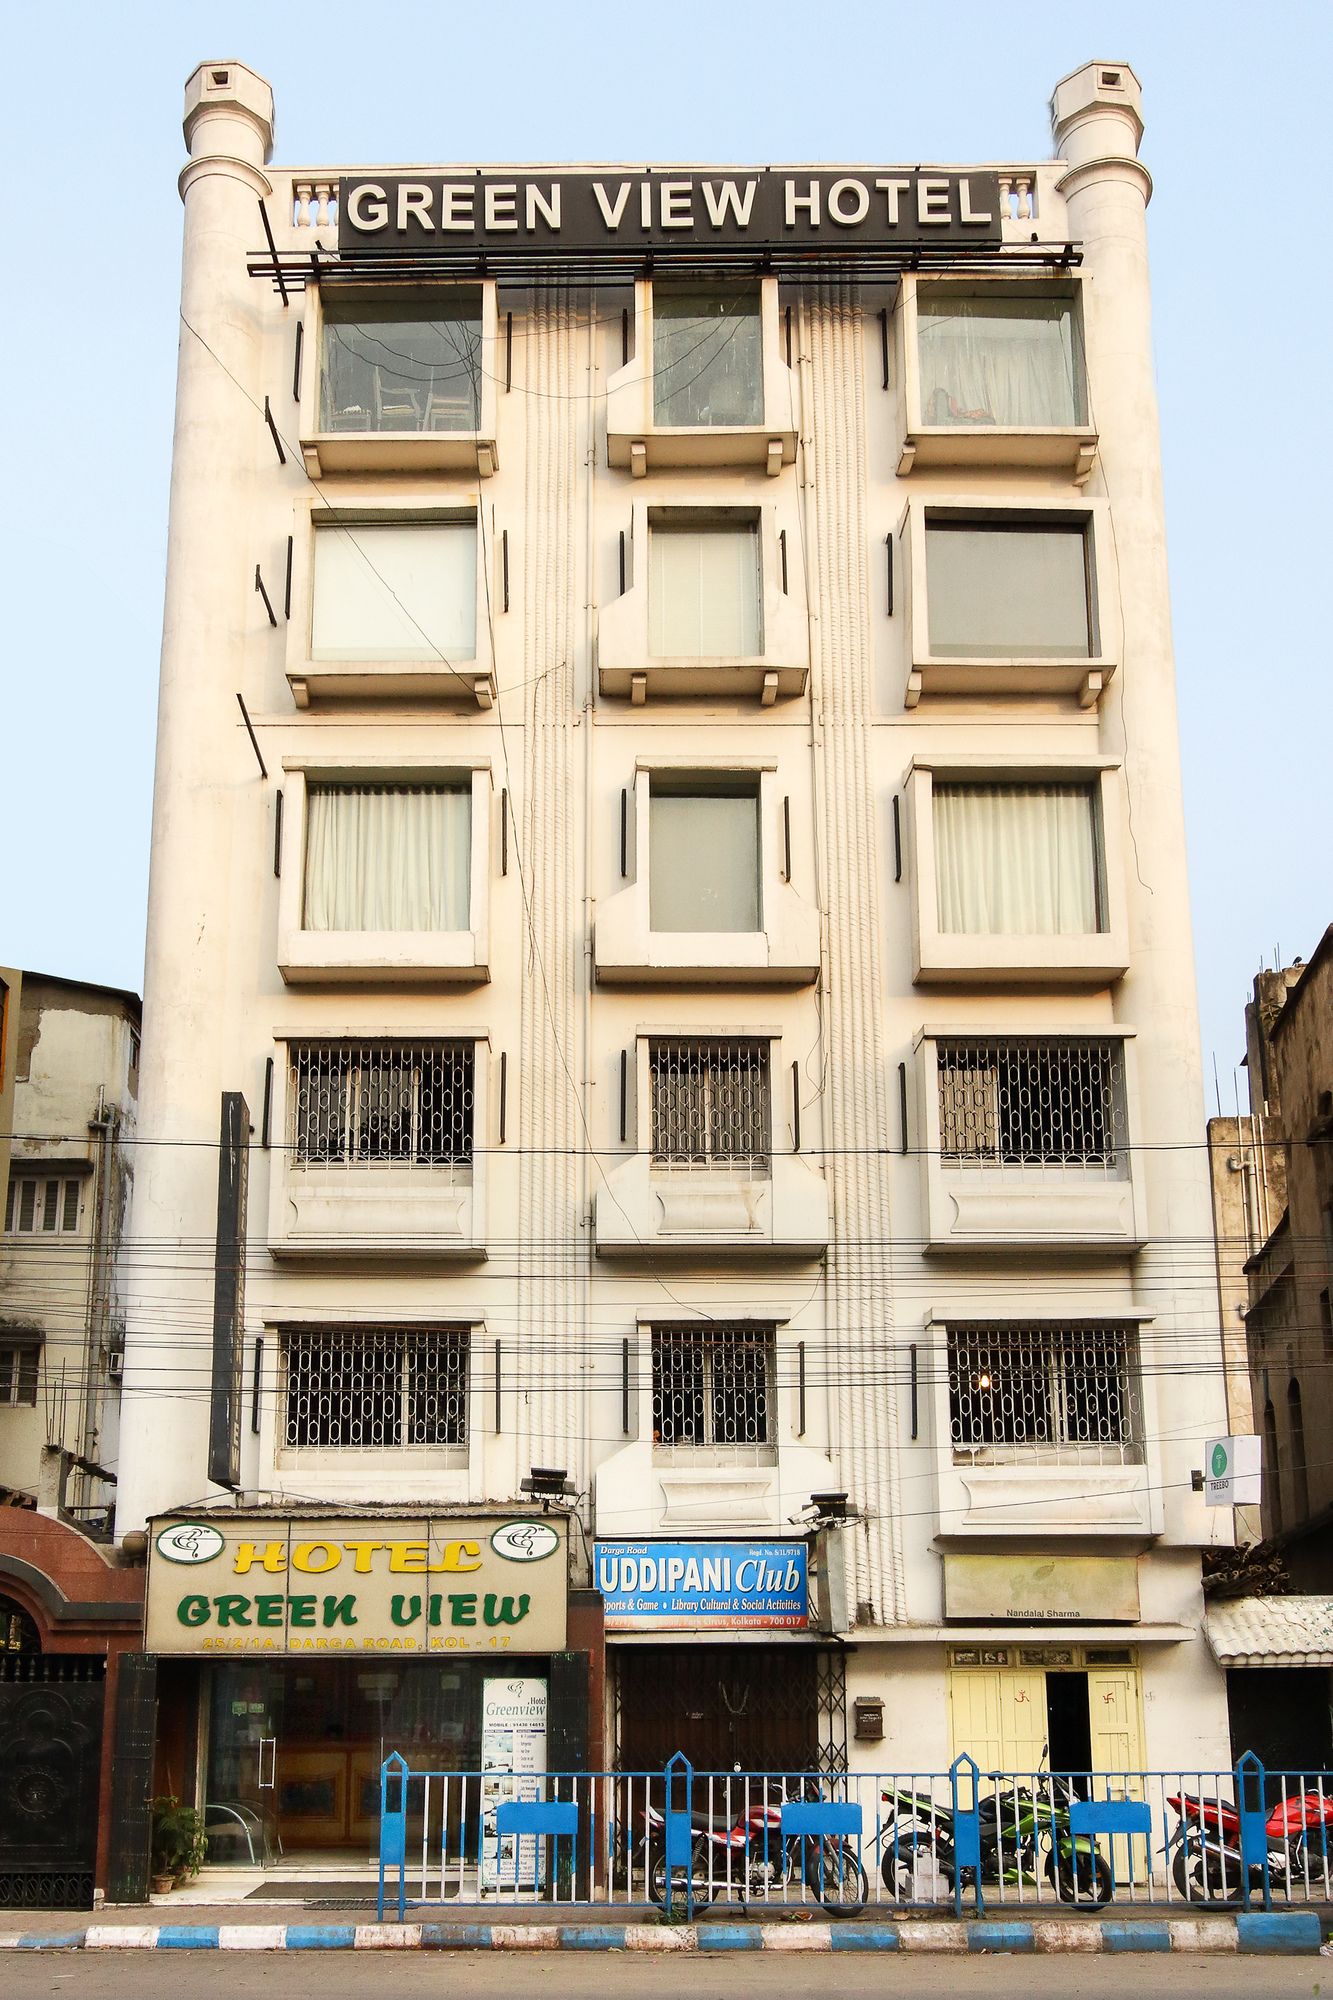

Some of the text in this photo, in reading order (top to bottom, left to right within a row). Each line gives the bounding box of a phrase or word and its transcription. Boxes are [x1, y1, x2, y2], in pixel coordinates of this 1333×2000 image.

[347, 178, 993, 233] GREEN VIEW HOTEL
[1211, 1481, 1229, 1490] TREEBO
[232, 1541, 483, 1574] HOTEL
[600, 1546, 648, 1556] Darga Road
[600, 1557, 801, 1593] UDDIPANI Club
[176, 1593, 358, 1627] GREEN
[628, 1598, 635, 1610] &
[636, 1598, 659, 1611] Game
[671, 1598, 699, 1613] Library
[700, 1598, 731, 1611] Cultural
[732, 1598, 740, 1610] &
[741, 1598, 765, 1610] Social
[766, 1598, 801, 1611] Activities
[1006, 1609, 1081, 1618] Nandalal Sharma
[731, 1616, 762, 1626] Kolkata
[769, 1616, 785, 1625] 700
[786, 1616, 801, 1625] 017
[202, 1637, 283, 1651] 25/2/1A,
[289, 1637, 357, 1649] DARGA
[363, 1637, 423, 1651] ROAD,
[431, 1636, 470, 1649] KOL
[488, 1636, 511, 1648] 17
[530, 1697, 547, 1705] Hotel
[486, 1702, 546, 1716] Greenview
